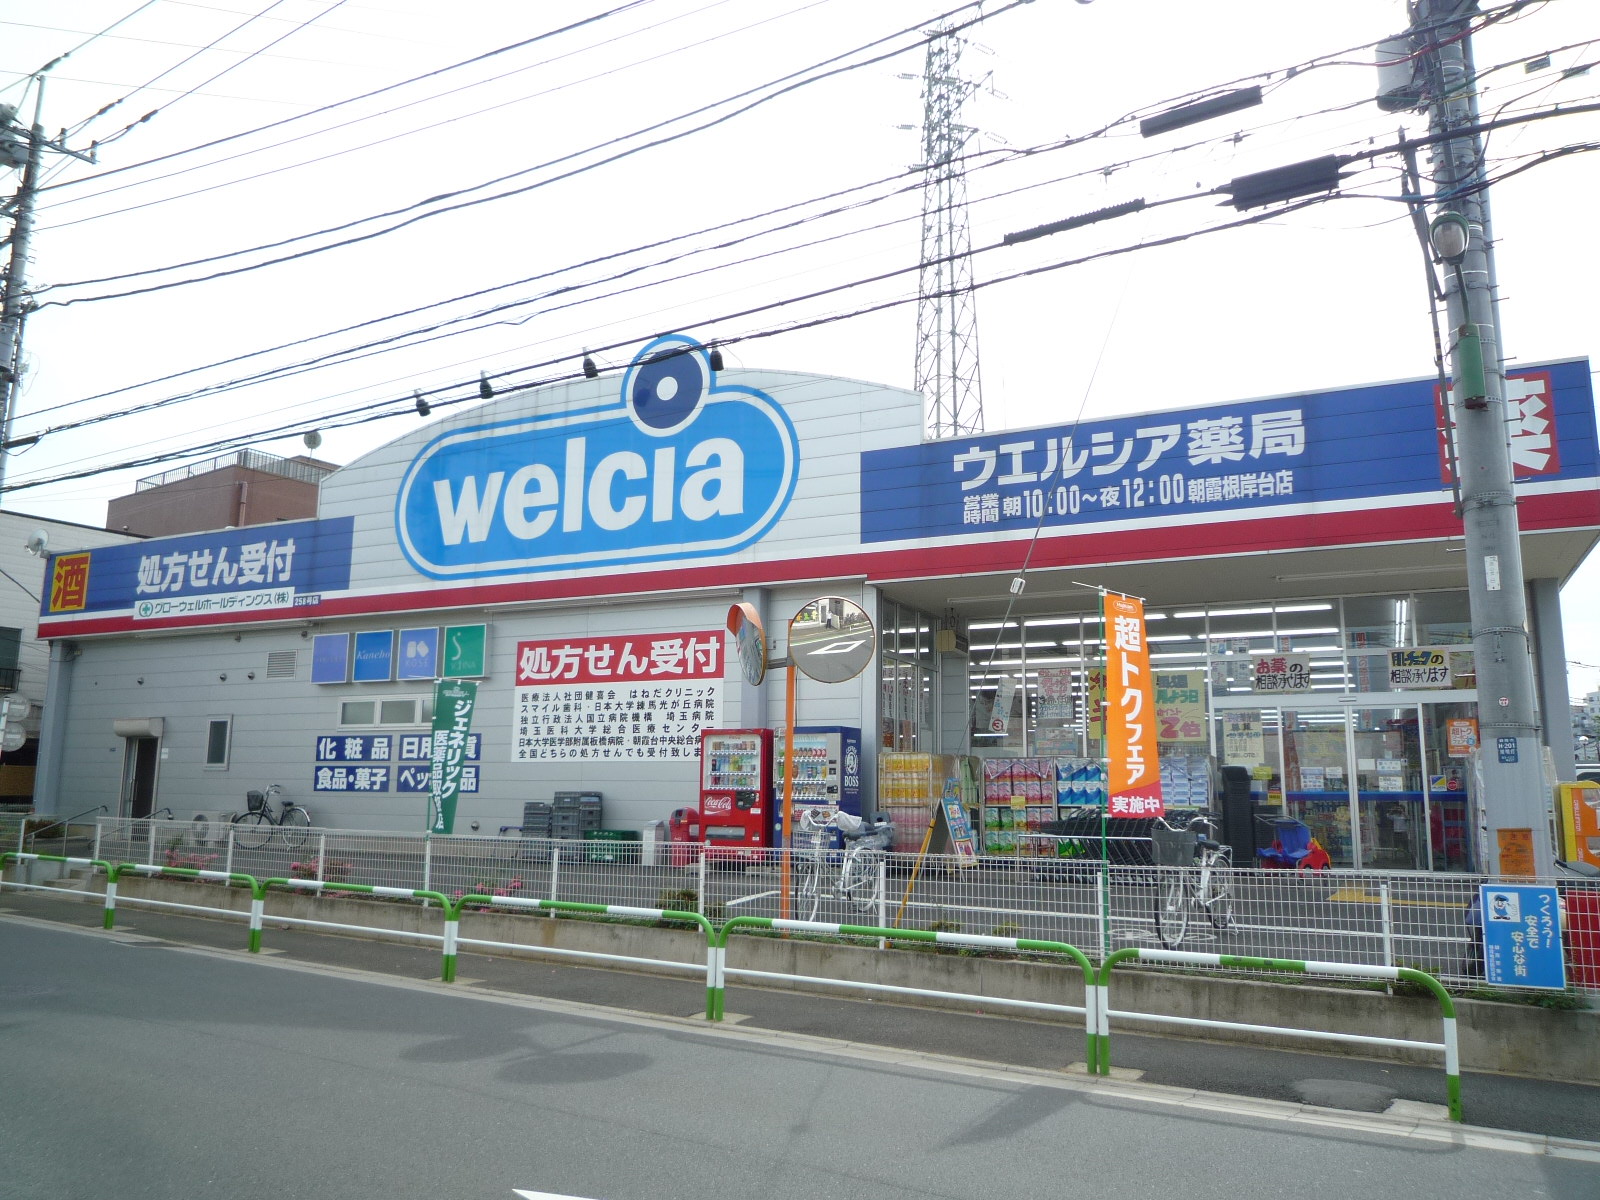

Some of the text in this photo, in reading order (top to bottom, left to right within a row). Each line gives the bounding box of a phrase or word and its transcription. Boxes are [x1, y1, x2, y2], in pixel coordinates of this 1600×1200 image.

[953, 409, 1306, 491] ウエルシア薬局
[433, 436, 744, 546] welcia
[963, 493, 999, 509] 営業
[1187, 469, 1294, 504] 朝霞根岸台店
[963, 508, 999, 525] 時間
[136, 537, 296, 595] 処方せん受付
[51, 555, 90, 610] 酒
[356, 650, 391, 661] Kanebo
[519, 635, 721, 681] 処方せん受付
[1256, 656, 1304, 674] お薬の
[1255, 670, 1310, 690] 相談承ります
[1390, 666, 1449, 684] 相談承ります
[629, 686, 716, 699] はねだクリニック
[1113, 615, 1145, 785] 超トクフェア
[666, 711, 715, 722] 埼玉病院
[319, 737, 390, 760] 化粧品
[441, 700, 473, 799] ジェネリック
[316, 767, 388, 791] 食品・菓子
[844, 775, 859, 787] BOSS
[1112, 796, 1160, 814] 実施中
[1525, 915, 1539, 949] 安全で
[1511, 931, 1527, 977] 安心な街
